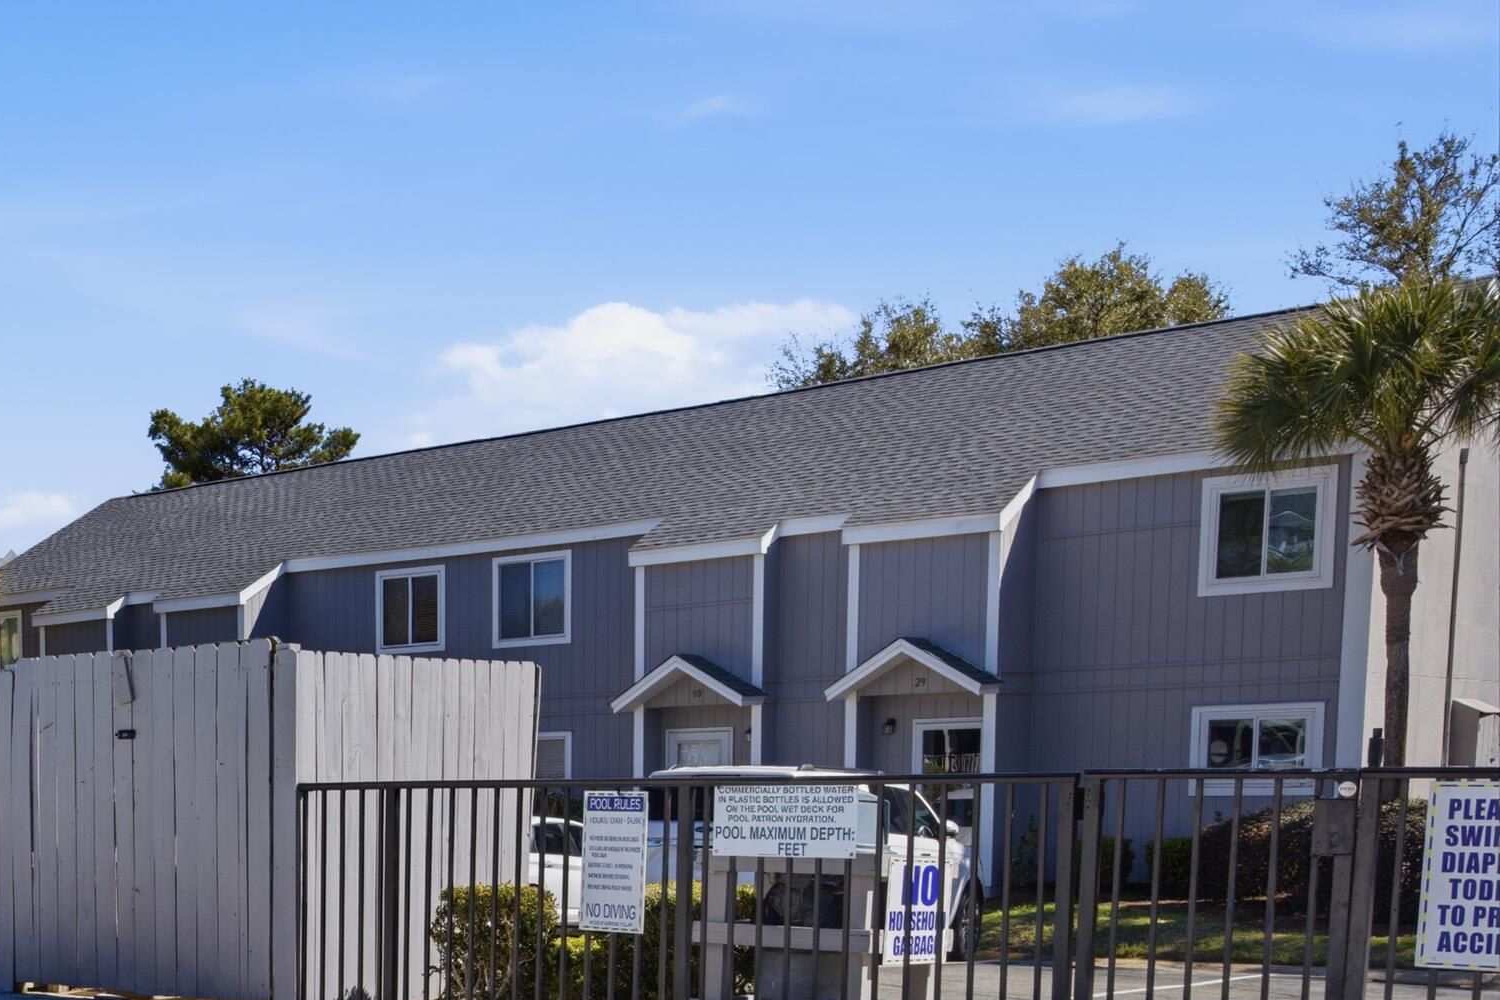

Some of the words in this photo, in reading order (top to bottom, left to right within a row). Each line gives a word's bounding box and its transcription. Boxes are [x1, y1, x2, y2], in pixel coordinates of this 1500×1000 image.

[718, 786, 781, 794] COMMERCIALLY
[783, 786, 821, 794] BOTTLED
[823, 786, 854, 794] WATER
[590, 797, 612, 810] POOL
[613, 798, 641, 810] RULES
[763, 796, 800, 804] BOTTLES
[802, 796, 810, 804] IS
[812, 796, 854, 804] ALLOWED
[726, 805, 738, 813] ON
[757, 805, 779, 813] POOL
[728, 814, 748, 822] POOL
[715, 826, 746, 839] POOL
[750, 826, 806, 840] MAXIMUM
[810, 827, 855, 841] DEPTH:
[778, 842, 807, 856] FEET
[1441, 851, 1500, 874] DIAP
[901, 865, 939, 906] NO
[586, 902, 601, 918] NO
[603, 903, 636, 920] DIVING
[1437, 905, 1465, 926] TO
[888, 911, 946, 931] HOSEHO
[1437, 931, 1500, 954] ACCI
